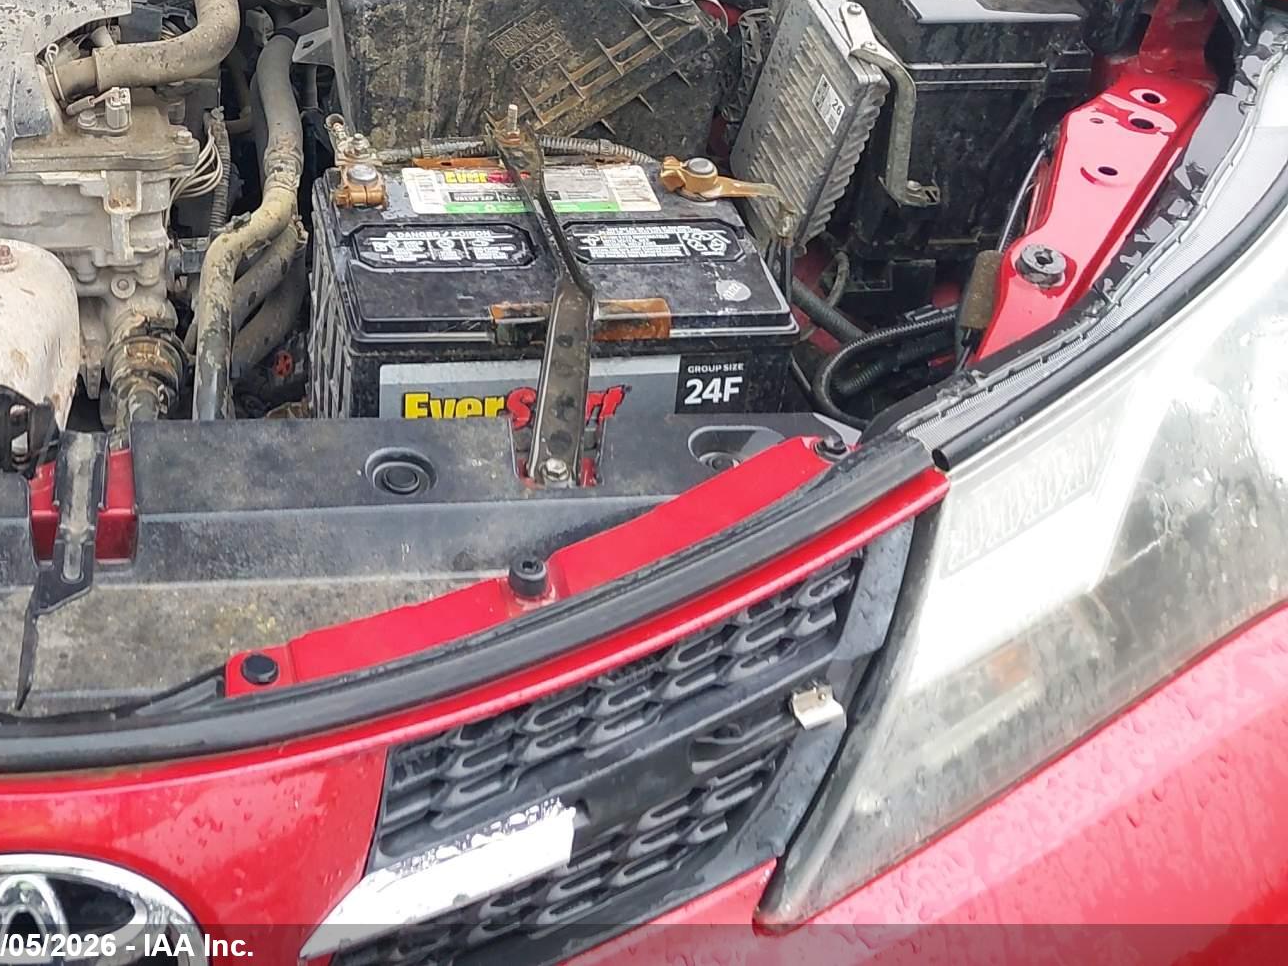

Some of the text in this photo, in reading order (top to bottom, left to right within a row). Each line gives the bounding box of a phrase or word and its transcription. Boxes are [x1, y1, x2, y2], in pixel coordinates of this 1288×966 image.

[831, 98, 843, 116] 26
[396, 230, 440, 239] DANGER
[451, 229, 491, 238] POISON
[687, 362, 745, 374] GROUP SIZE
[684, 376, 743, 405] 24F
[403, 384, 626, 429] EverSrt
